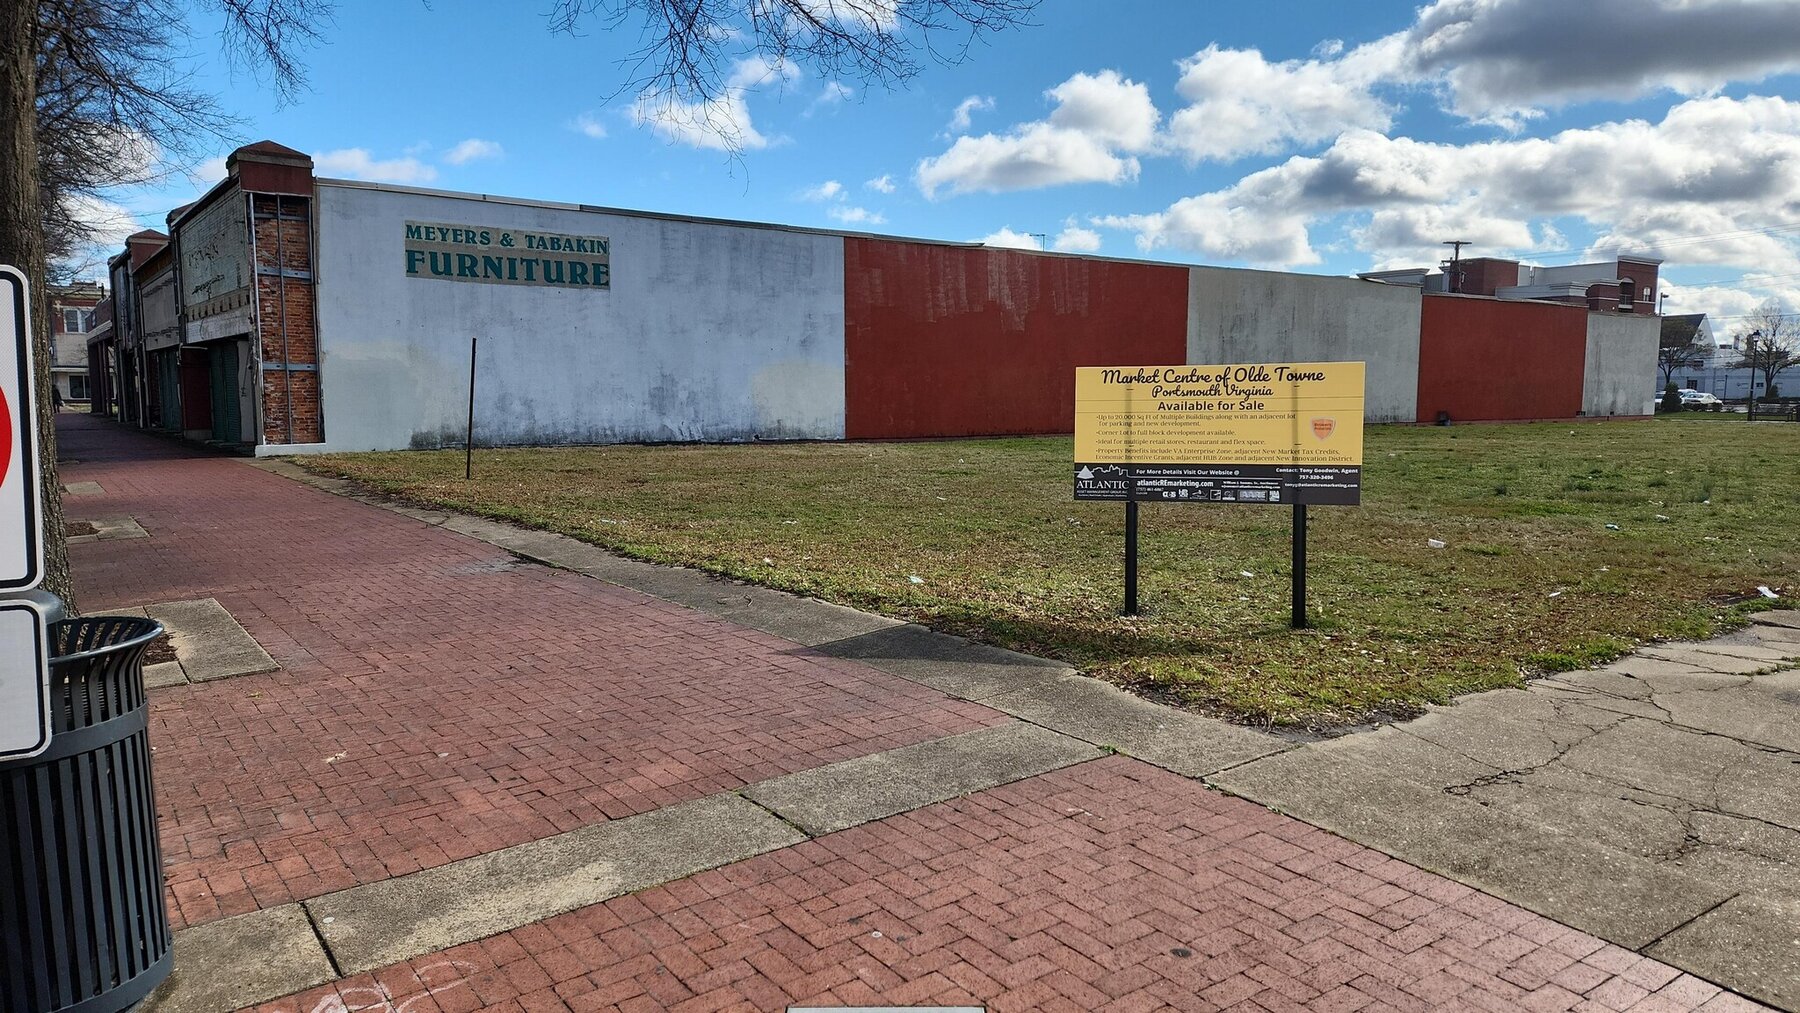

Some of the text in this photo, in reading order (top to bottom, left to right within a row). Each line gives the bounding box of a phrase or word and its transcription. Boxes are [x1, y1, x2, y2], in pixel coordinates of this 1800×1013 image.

[406, 224, 608, 254] MEYERS & TABAKIN
[406, 249, 609, 286] FURNITURE
[1101, 366, 1325, 387] Market Centre of Olde Towne
[1151, 383, 1274, 401] Portsmouth Virginia
[1158, 400, 1265, 411] Available for Sale
[1076, 480, 1130, 489] ATLANTIC
[1136, 479, 1214, 488] atlanticREmarketing.com
